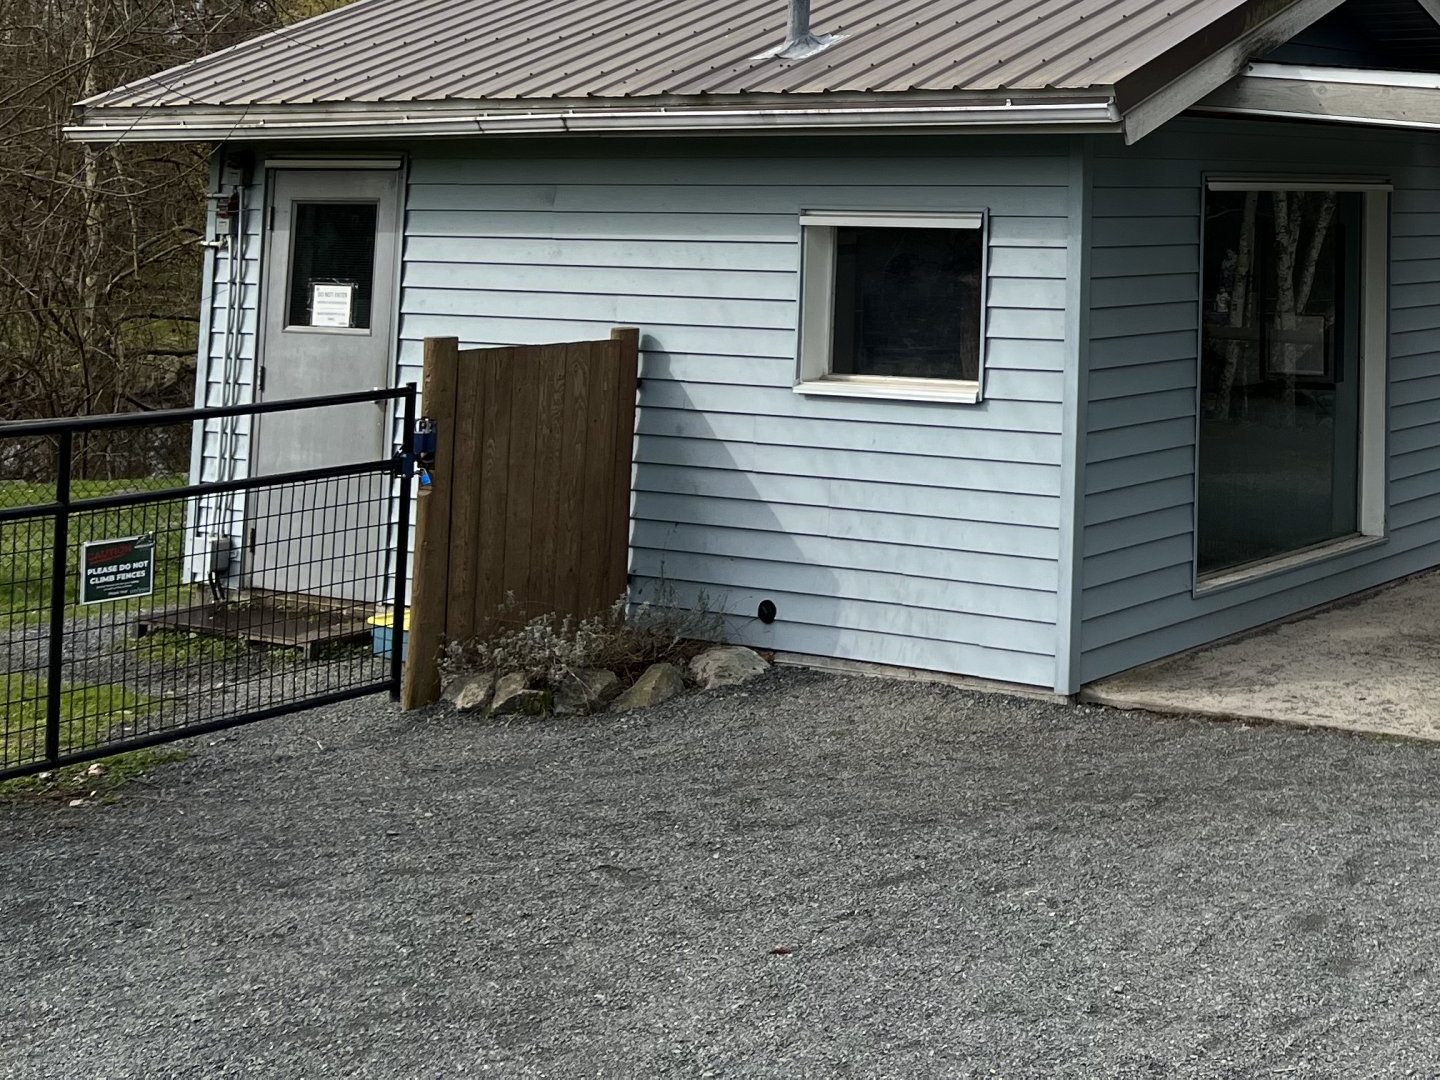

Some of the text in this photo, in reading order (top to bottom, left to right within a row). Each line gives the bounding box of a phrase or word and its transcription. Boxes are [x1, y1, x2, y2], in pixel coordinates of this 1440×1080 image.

[87, 560, 148, 575] PLEASE DO NOT
[90, 570, 145, 584] CLIMB FENCES
